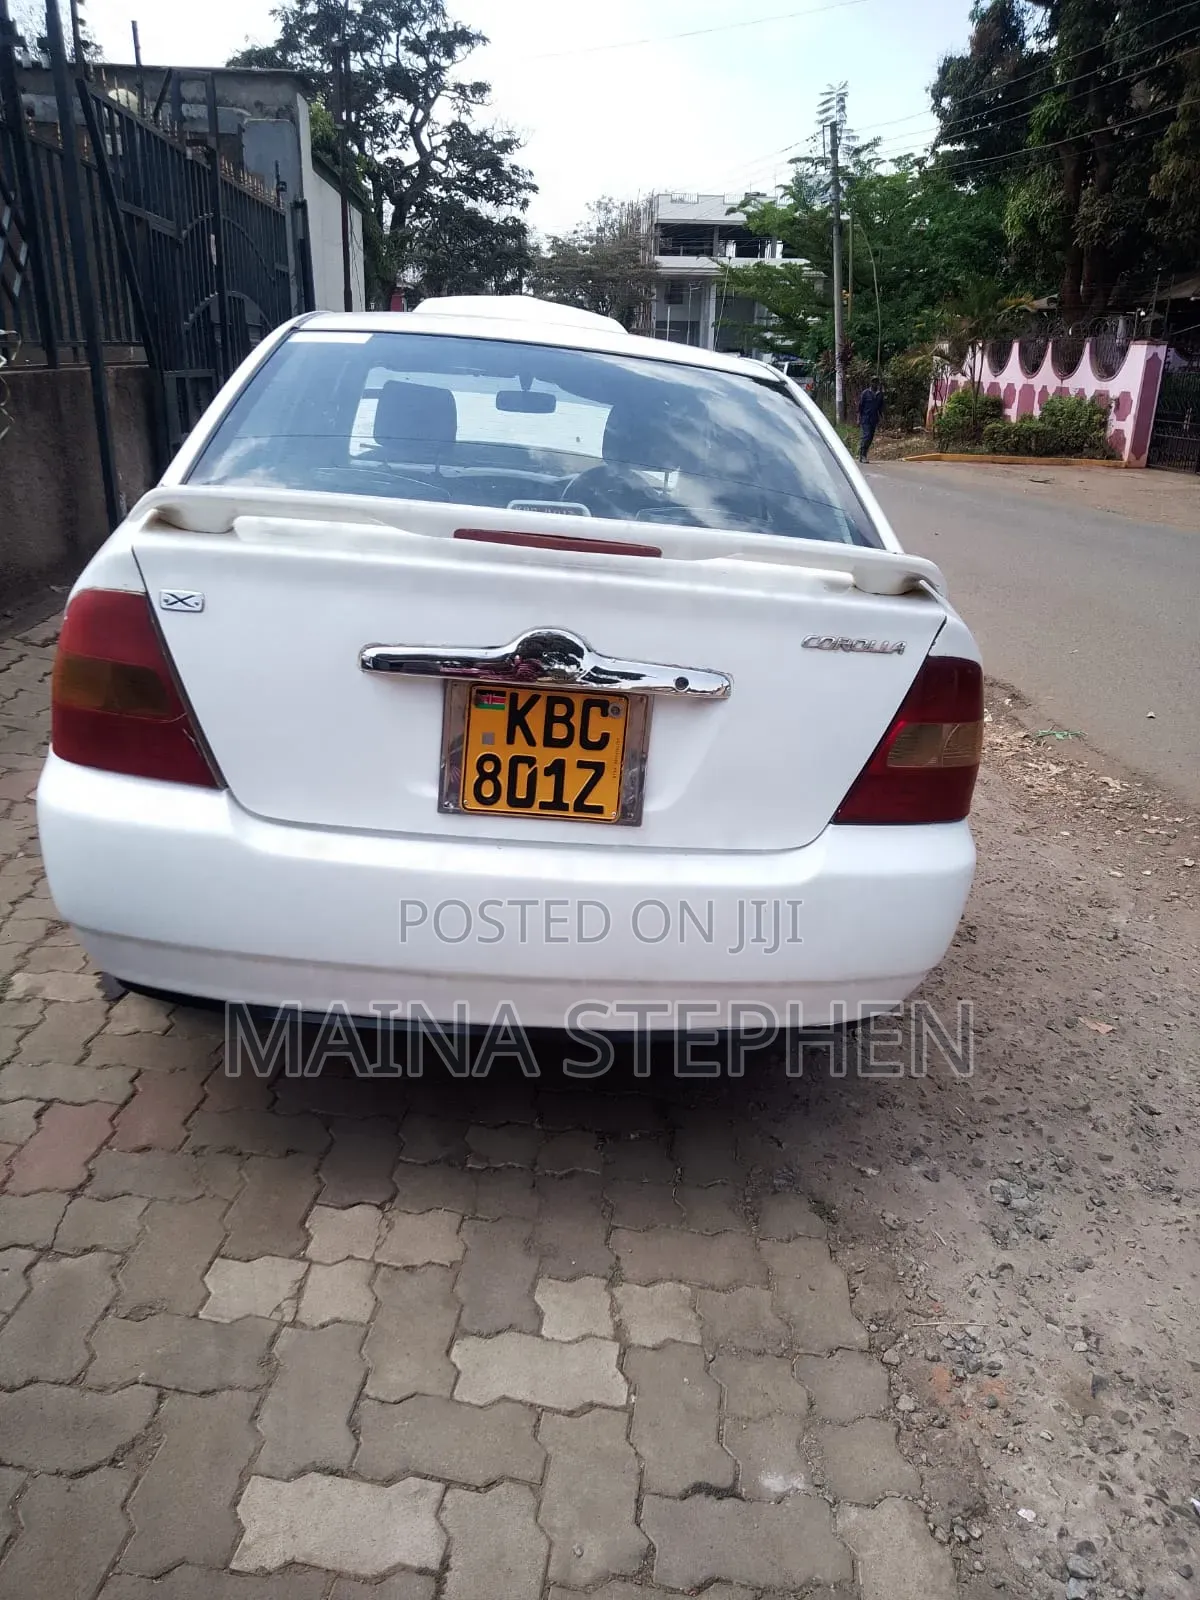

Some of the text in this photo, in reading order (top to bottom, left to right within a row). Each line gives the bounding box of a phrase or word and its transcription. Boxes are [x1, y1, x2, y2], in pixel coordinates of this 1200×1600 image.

[801, 634, 907, 656] COROLLA
[506, 692, 612, 751] KBC
[473, 752, 606, 815] 801Z
